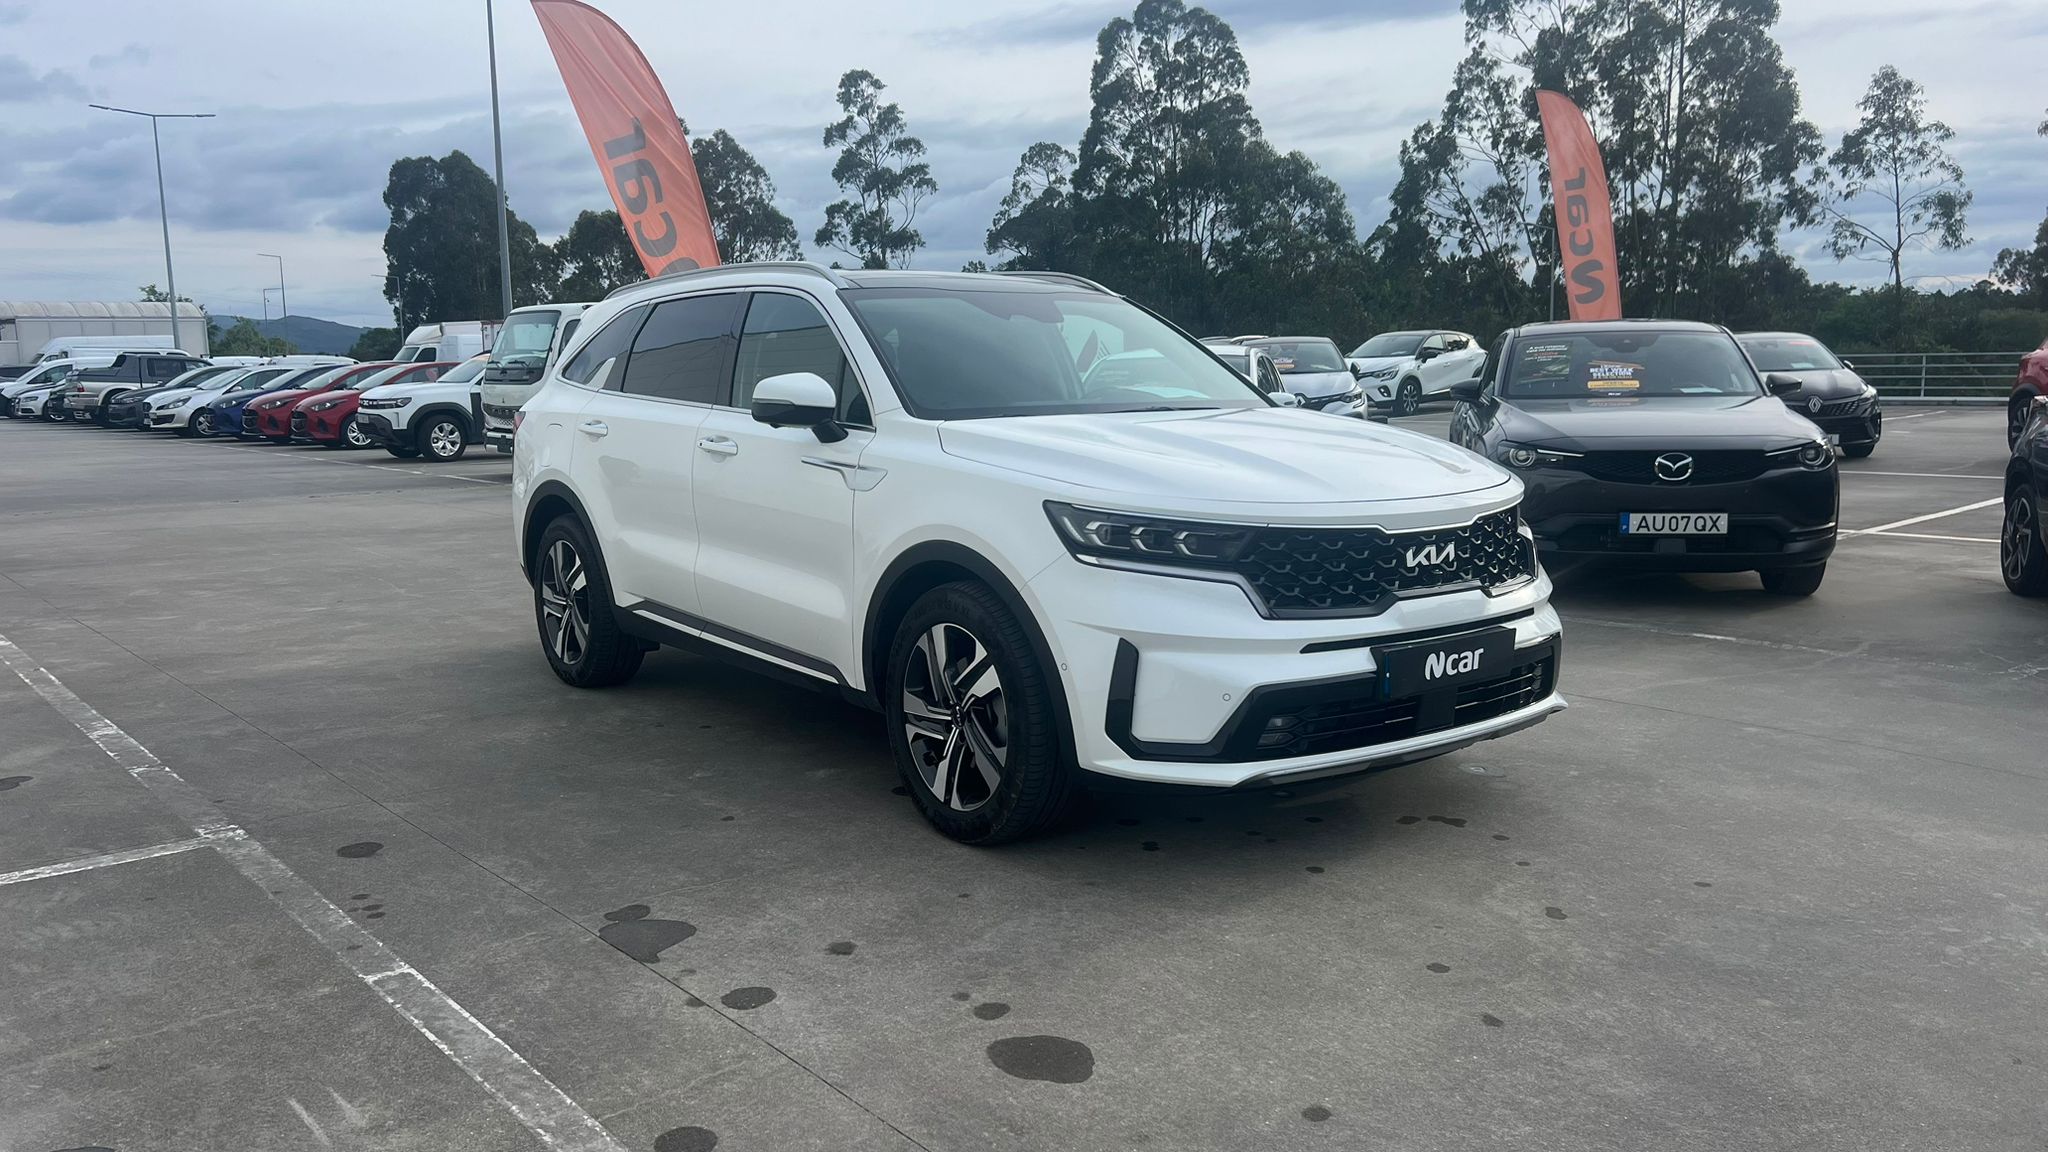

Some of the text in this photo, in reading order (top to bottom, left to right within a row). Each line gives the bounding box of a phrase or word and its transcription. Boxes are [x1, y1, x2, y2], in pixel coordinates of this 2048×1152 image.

[1636, 515, 1721, 532] AU07QX
[1406, 541, 1456, 567] KIA
[1424, 648, 1484, 680] Ncar
